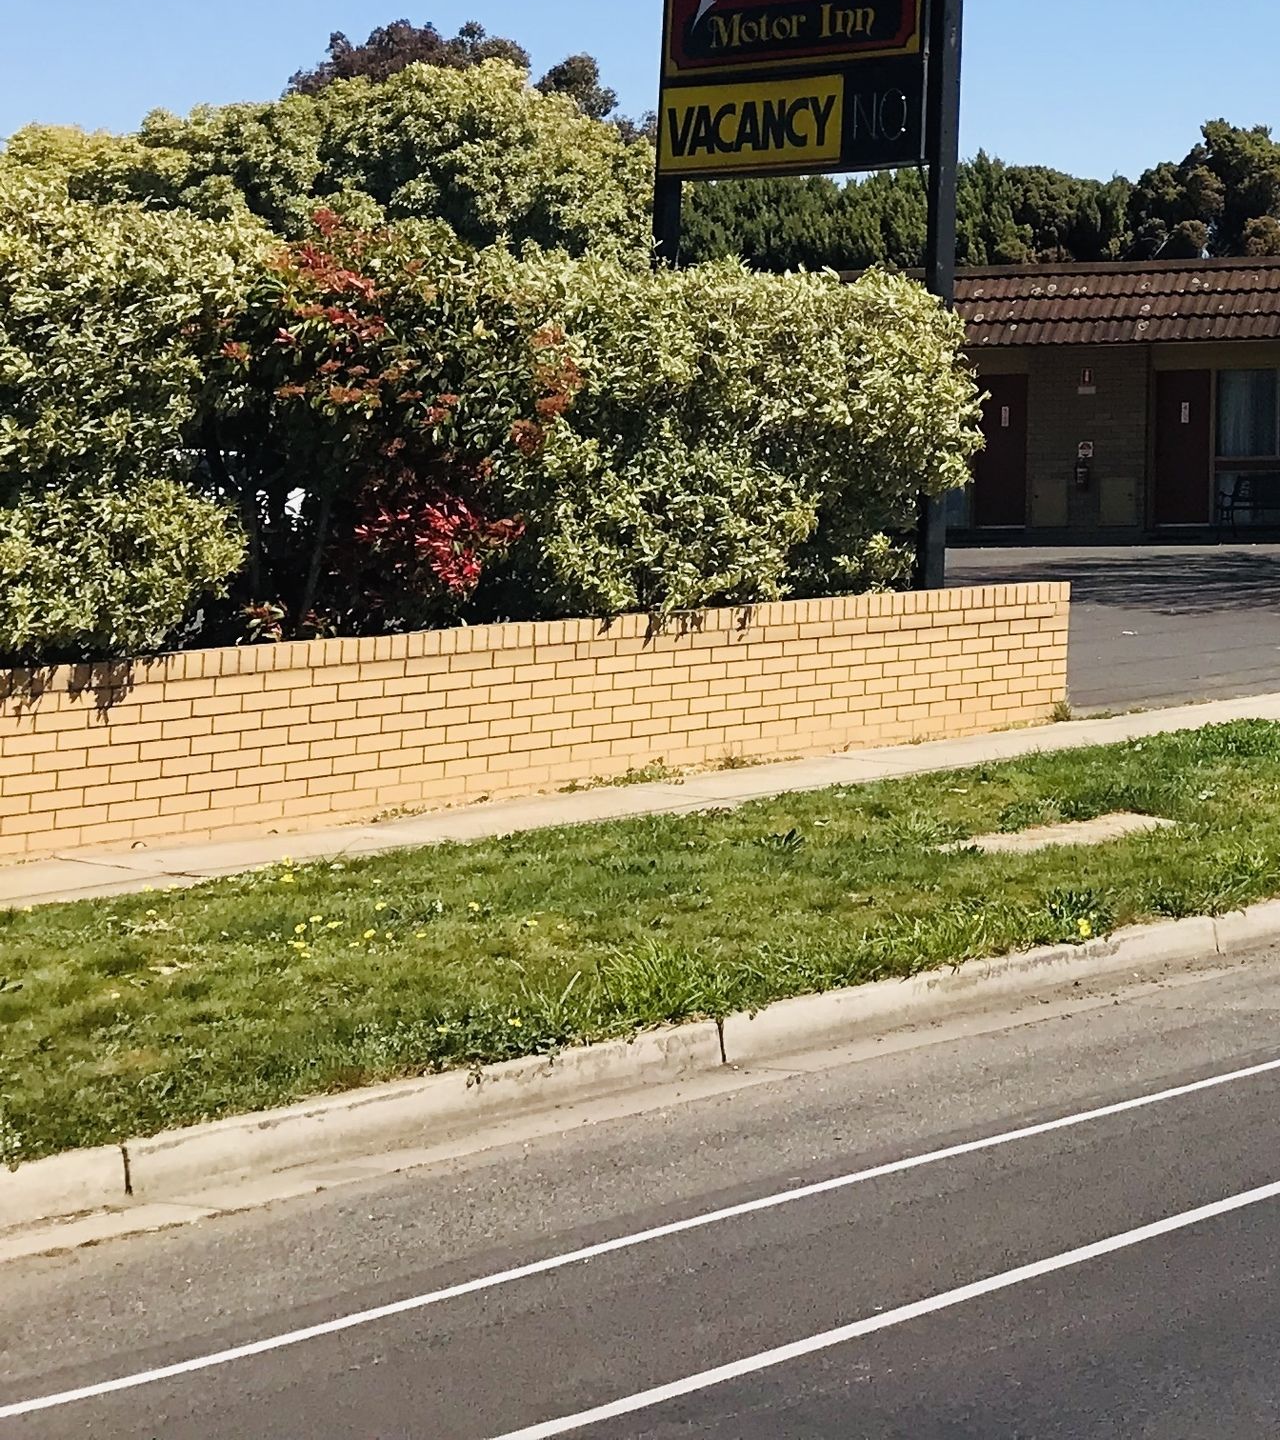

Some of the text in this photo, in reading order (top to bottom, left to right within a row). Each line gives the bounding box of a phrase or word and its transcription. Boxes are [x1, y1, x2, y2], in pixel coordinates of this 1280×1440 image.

[708, 3, 877, 49] Motor Inn
[667, 87, 907, 158] VACANCY NO
